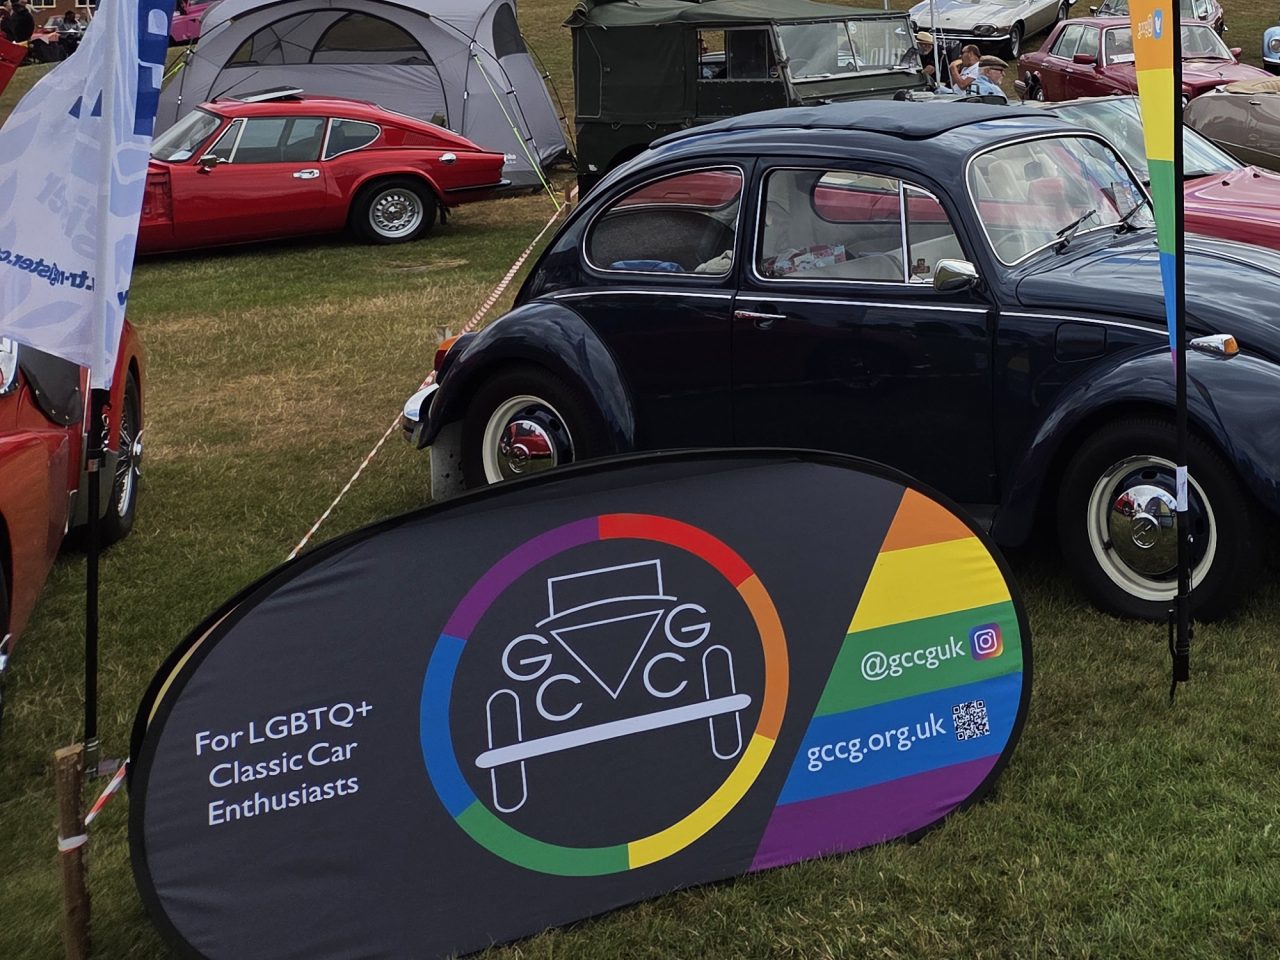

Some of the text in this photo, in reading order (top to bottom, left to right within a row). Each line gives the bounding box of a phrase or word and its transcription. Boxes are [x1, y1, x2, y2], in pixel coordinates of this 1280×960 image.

[860, 636, 966, 681] @gccguk
[195, 700, 373, 756] For LGBTQ+
[807, 712, 947, 772] gccg.org.uk
[208, 742, 358, 788] Classic Car
[208, 776, 360, 826] Enthusiasts
